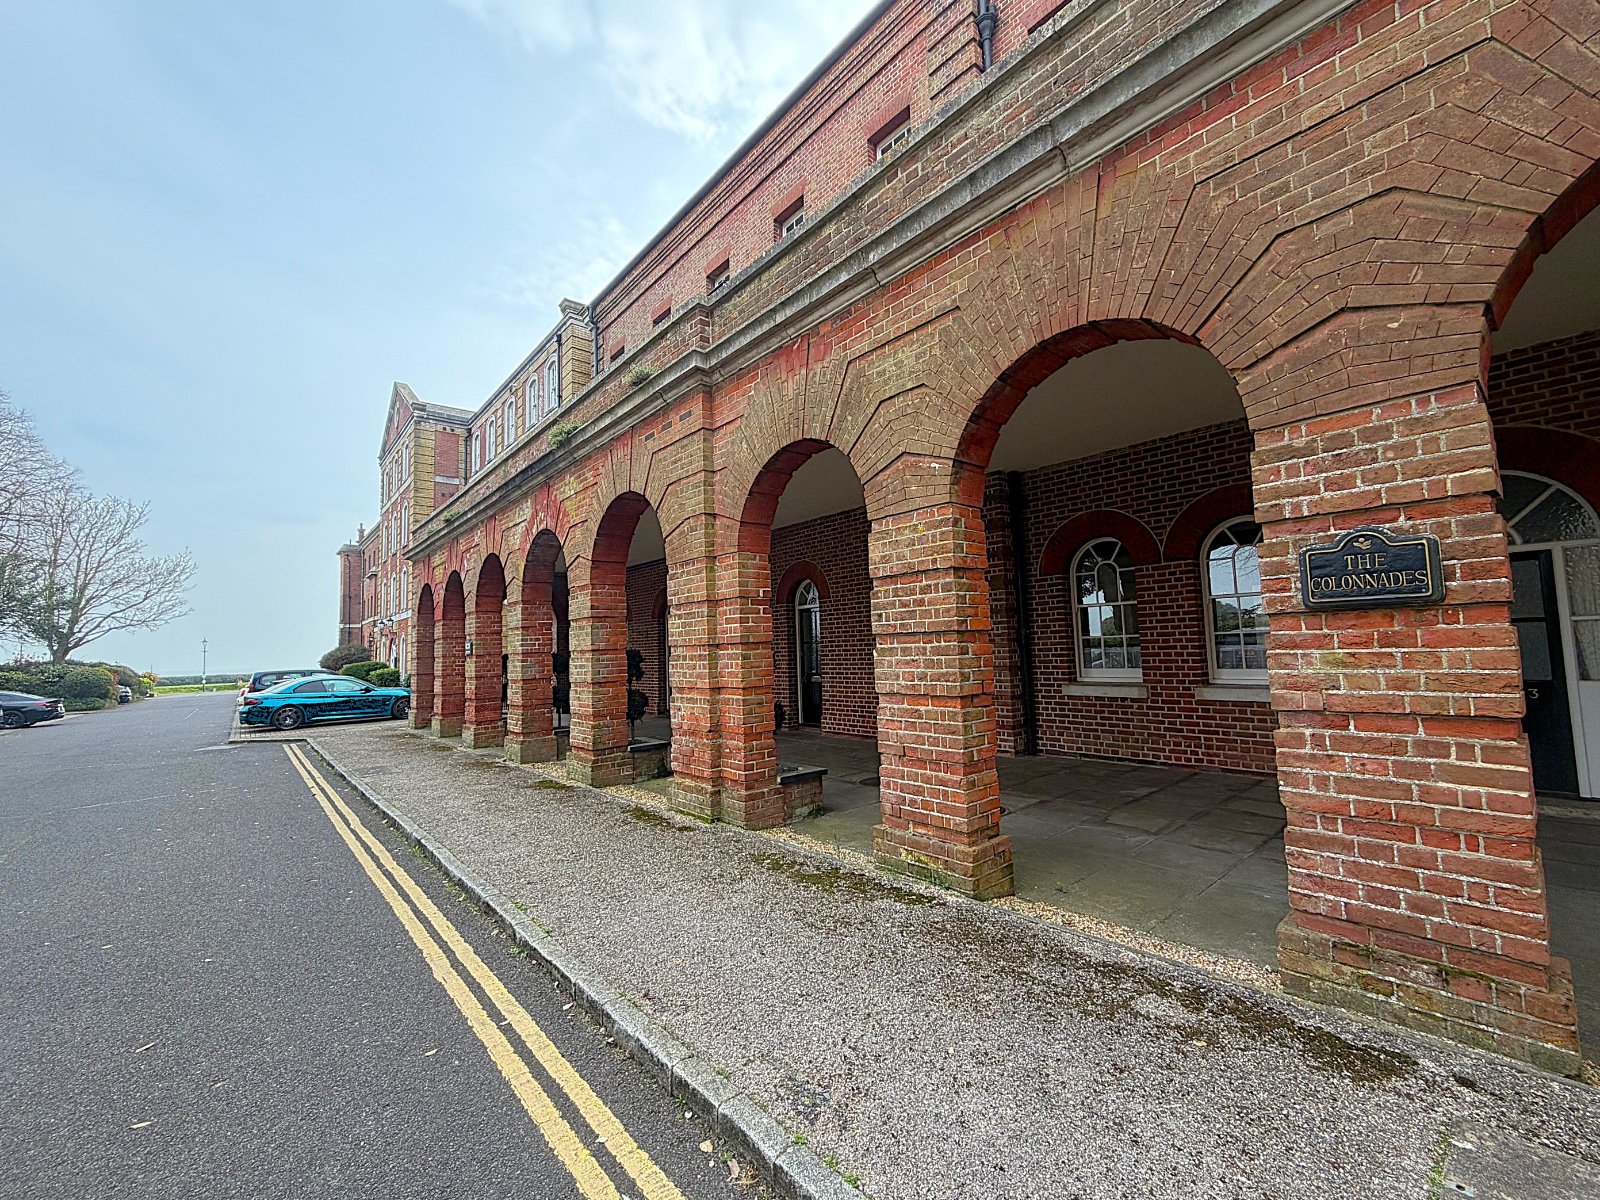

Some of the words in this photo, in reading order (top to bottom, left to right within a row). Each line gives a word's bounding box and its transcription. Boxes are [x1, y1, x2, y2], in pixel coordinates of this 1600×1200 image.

[1344, 552, 1388, 570] THE
[1310, 570, 1428, 592] COLONNADES
[1528, 688, 1539, 699] 3
